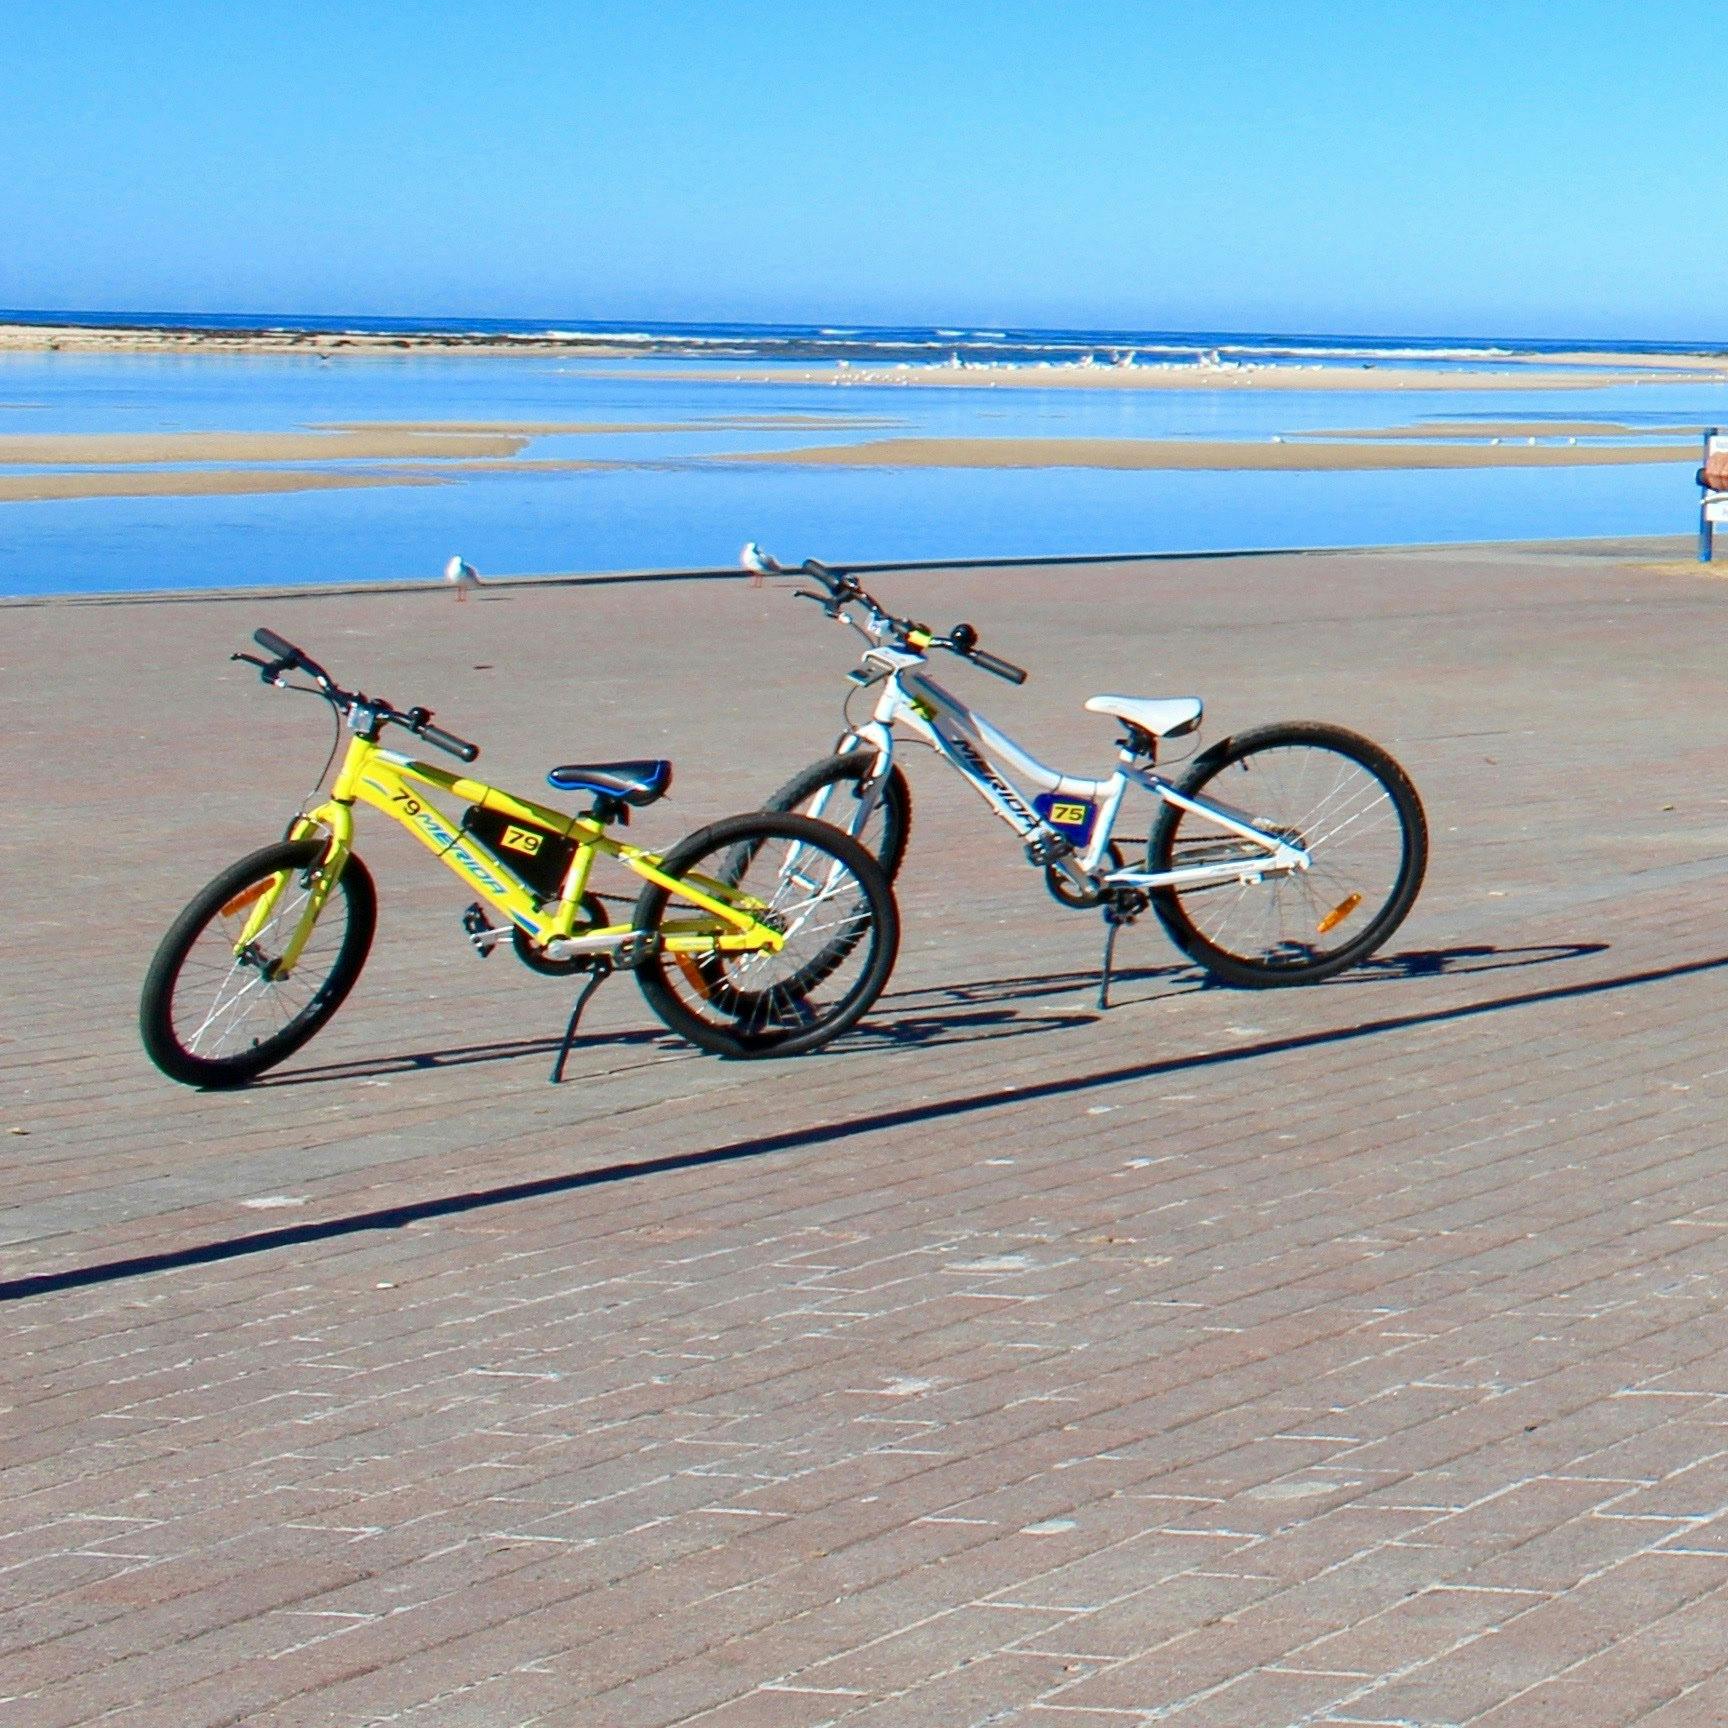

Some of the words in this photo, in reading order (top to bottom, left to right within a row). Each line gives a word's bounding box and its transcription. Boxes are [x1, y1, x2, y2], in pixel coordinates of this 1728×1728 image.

[391, 787, 421, 816] 79
[1053, 805, 1084, 821] 75
[414, 812, 508, 894] MERIDA
[508, 828, 542, 852] 79
